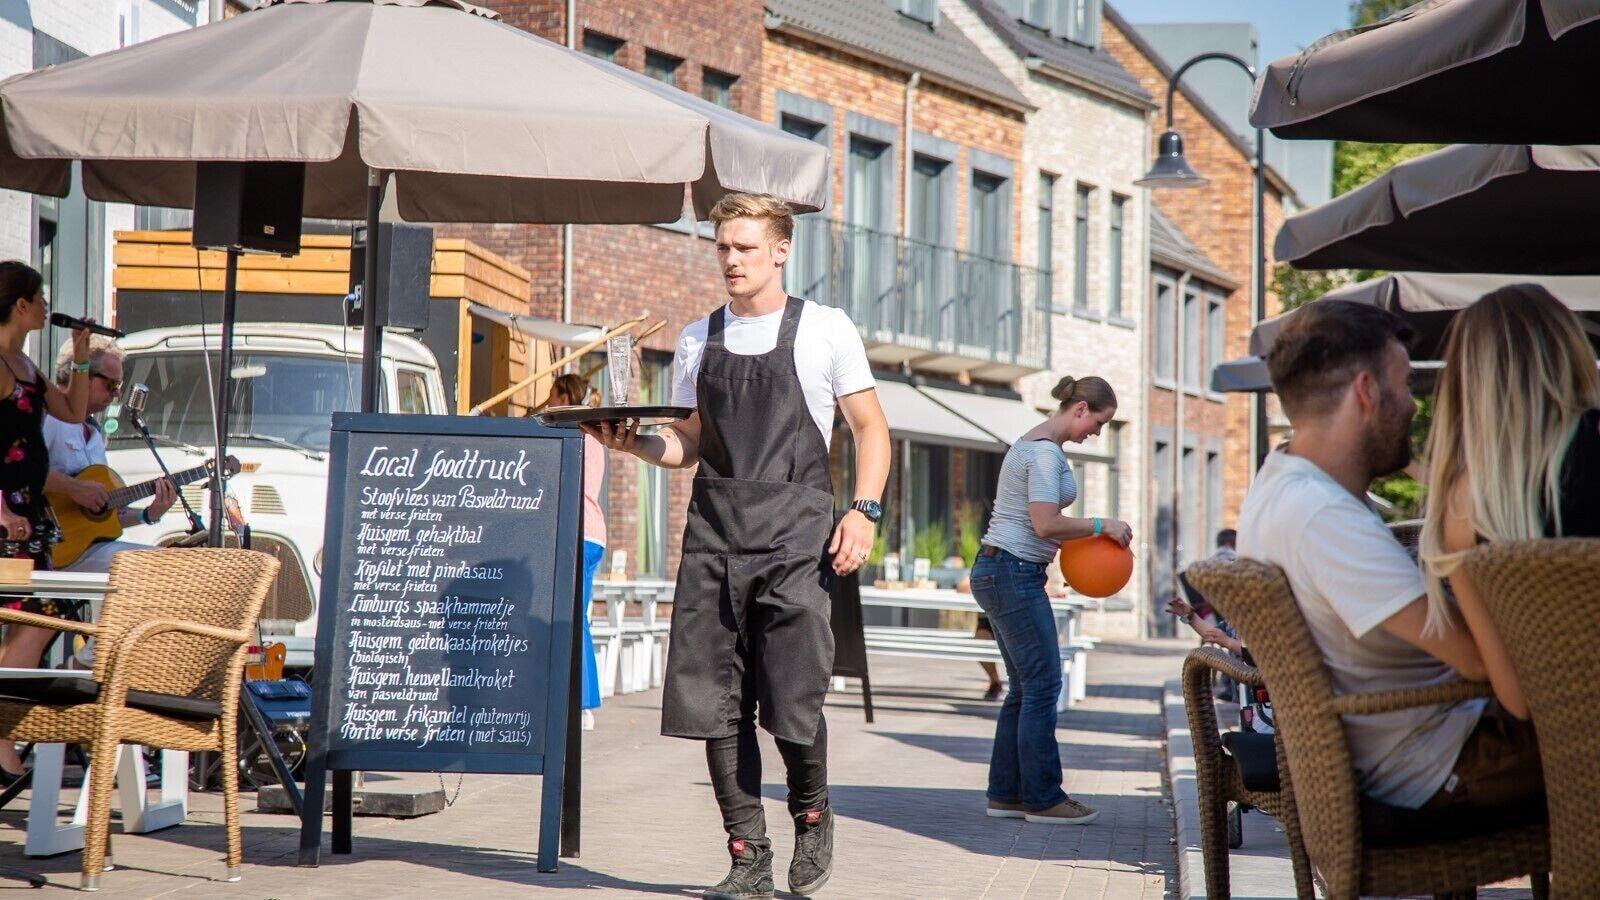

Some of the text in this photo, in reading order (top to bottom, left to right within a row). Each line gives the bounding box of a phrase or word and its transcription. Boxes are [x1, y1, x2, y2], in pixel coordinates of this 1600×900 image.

[360, 446, 531, 492] Local foodtruck
[360, 484, 544, 512] Stoofvlees van Pasveldrund
[361, 507, 442, 528] met verse frieten
[356, 523, 483, 547] Huisgem. gehaktbal
[357, 543, 445, 565] met verse frieten
[354, 559, 503, 583] Kipfilet met pindasaus
[353, 579, 437, 599] met verse frieten
[346, 593, 515, 620] Limburgs spaakhammetje
[351, 616, 361, 627] in
[448, 620, 472, 630] verse
[473, 616, 508, 636] frieten
[348, 630, 529, 656] Huisgem. geitenkaaskroketjes
[349, 651, 409, 669] (biologisch)
[347, 665, 516, 690] Huisgem. heuvellandkroket
[348, 688, 439, 704] van pasveldrund
[343, 702, 531, 730] Huisgem. frikandel (glutenvrij)
[340, 722, 532, 749] Portie verse frieten (met saus)
